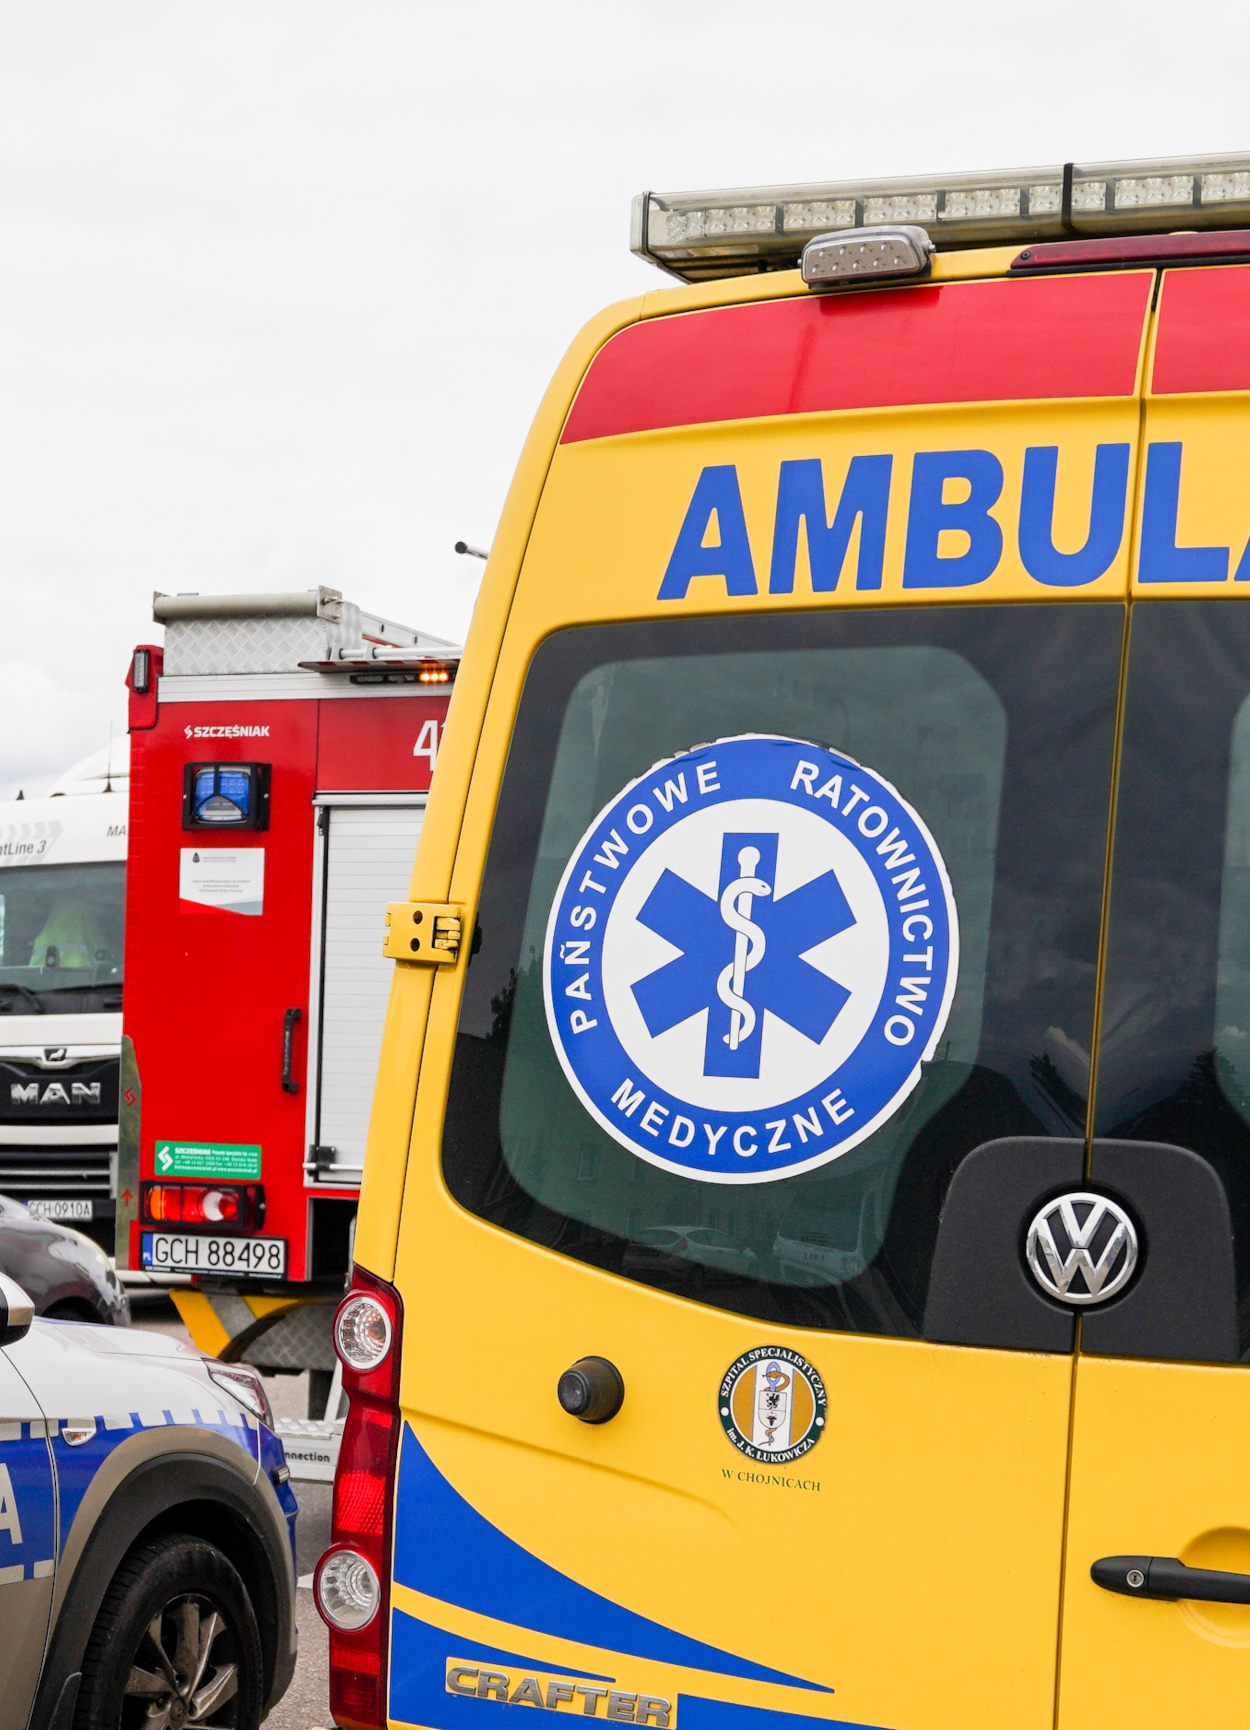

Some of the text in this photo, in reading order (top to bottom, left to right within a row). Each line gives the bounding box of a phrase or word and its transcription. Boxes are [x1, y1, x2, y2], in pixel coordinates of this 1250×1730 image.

[194, 725, 270, 738] SZCZĘŚNIAK
[413, 719, 446, 772] 4
[106, 825, 127, 837] MA
[36, 840, 47, 854] 3
[790, 760, 934, 1047] RATOWNICTWO
[10, 1083, 101, 1104] MAN
[610, 1077, 856, 1158] MEDYCZNE
[54, 1201, 90, 1216] 0910A
[155, 1237, 280, 1270] GCH 88498
[721, 1347, 827, 1407] SZPITAL SPECJALISTYCZNY
[284, 1452, 330, 1463] nnection
[721, 1469, 822, 1493] W CHOJNICACH
[446, 1665, 672, 1727] CRAFTER
